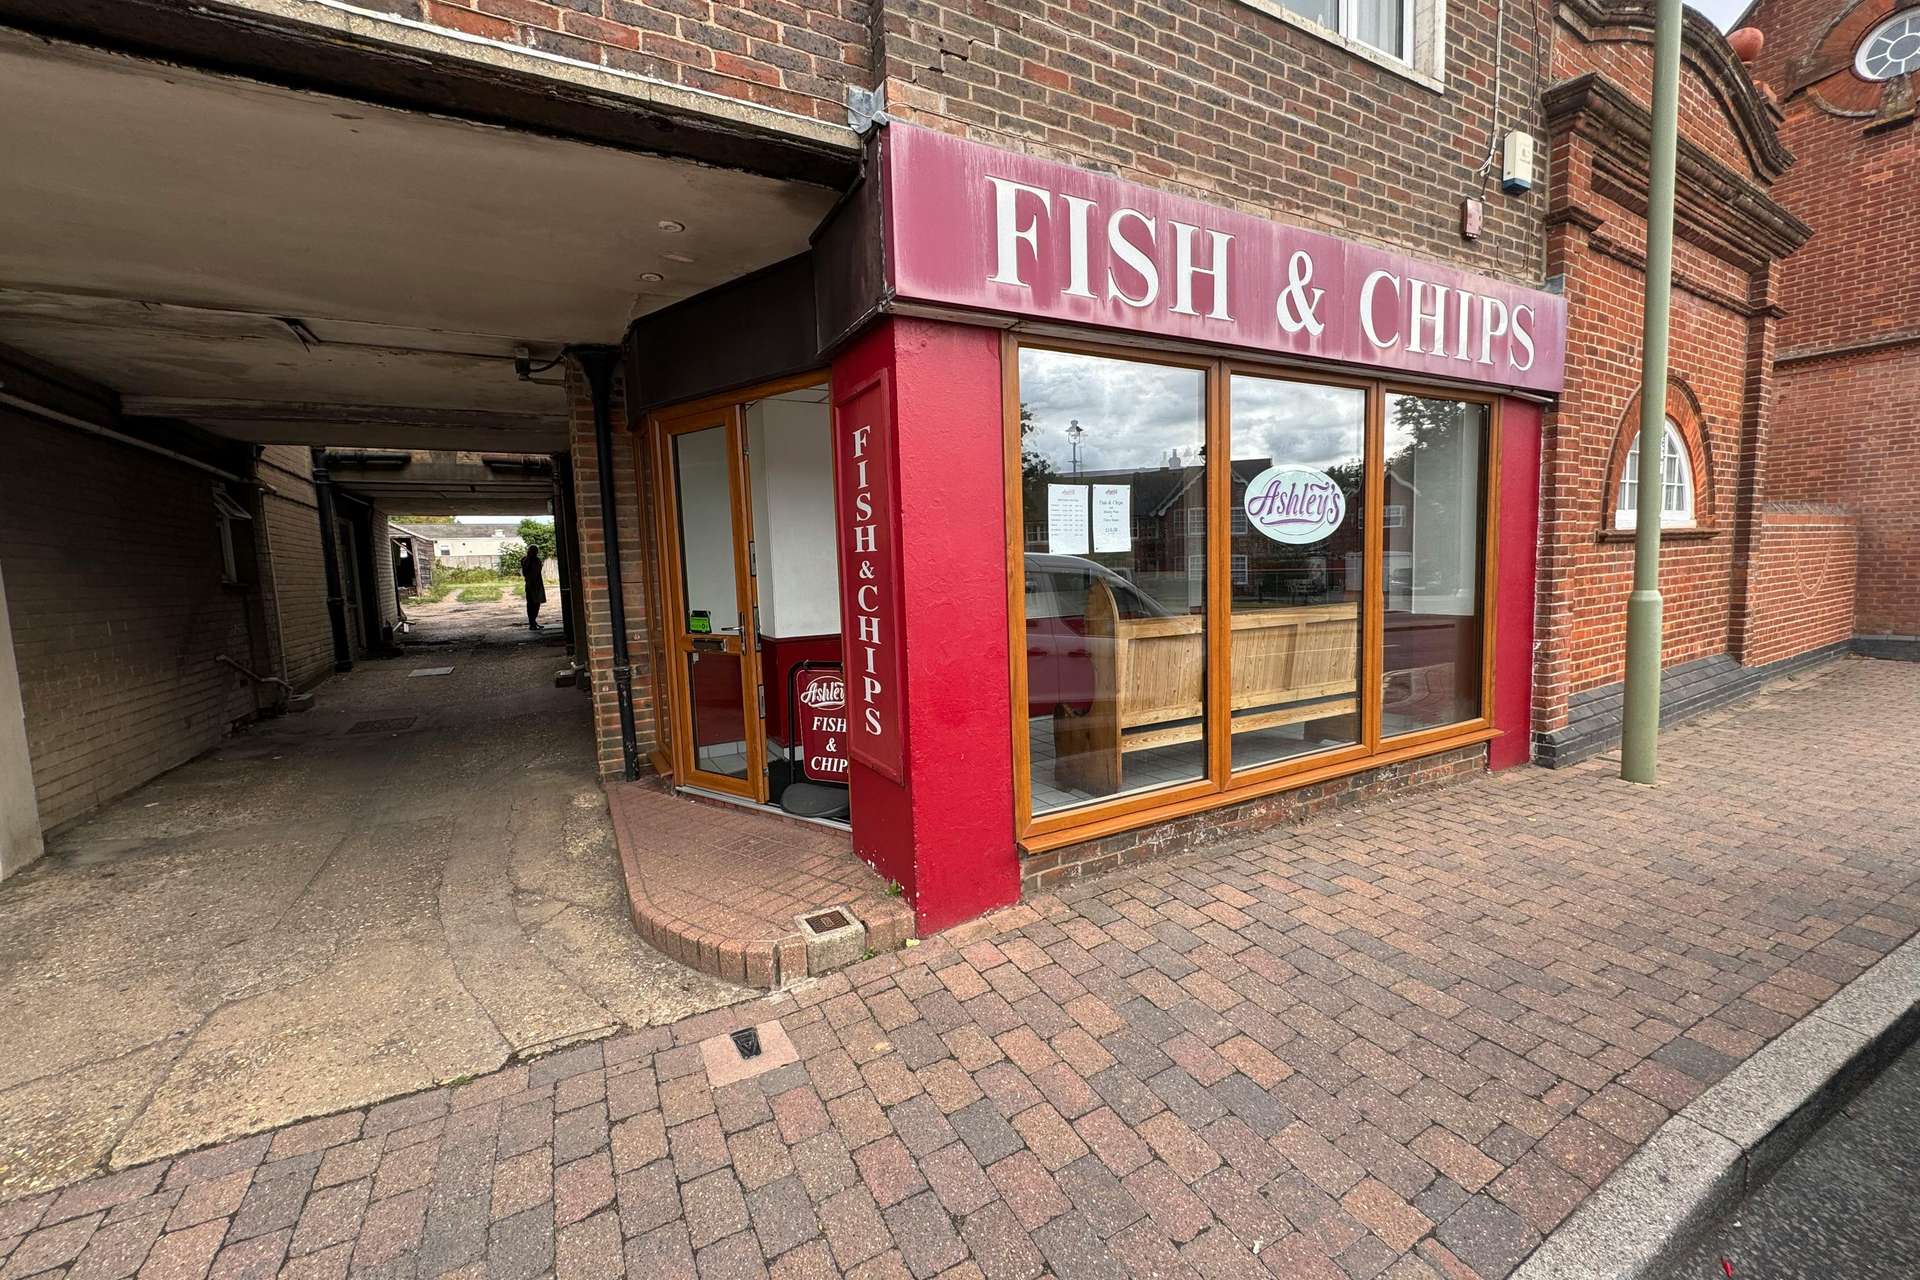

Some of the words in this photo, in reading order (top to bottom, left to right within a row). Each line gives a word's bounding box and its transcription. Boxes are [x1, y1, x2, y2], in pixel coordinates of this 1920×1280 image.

[985, 175, 1236, 322] FISH
[1275, 250, 1325, 336] &
[1359, 270, 1536, 371] CHIPS
[852, 425, 878, 553] FISH
[1248, 479, 1340, 525] Ashley's
[858, 560, 875, 579] &
[857, 584, 882, 736] CHIPS
[812, 716, 847, 733] FISH
[825, 737, 837, 752] &
[811, 756, 849, 773] CHIP
